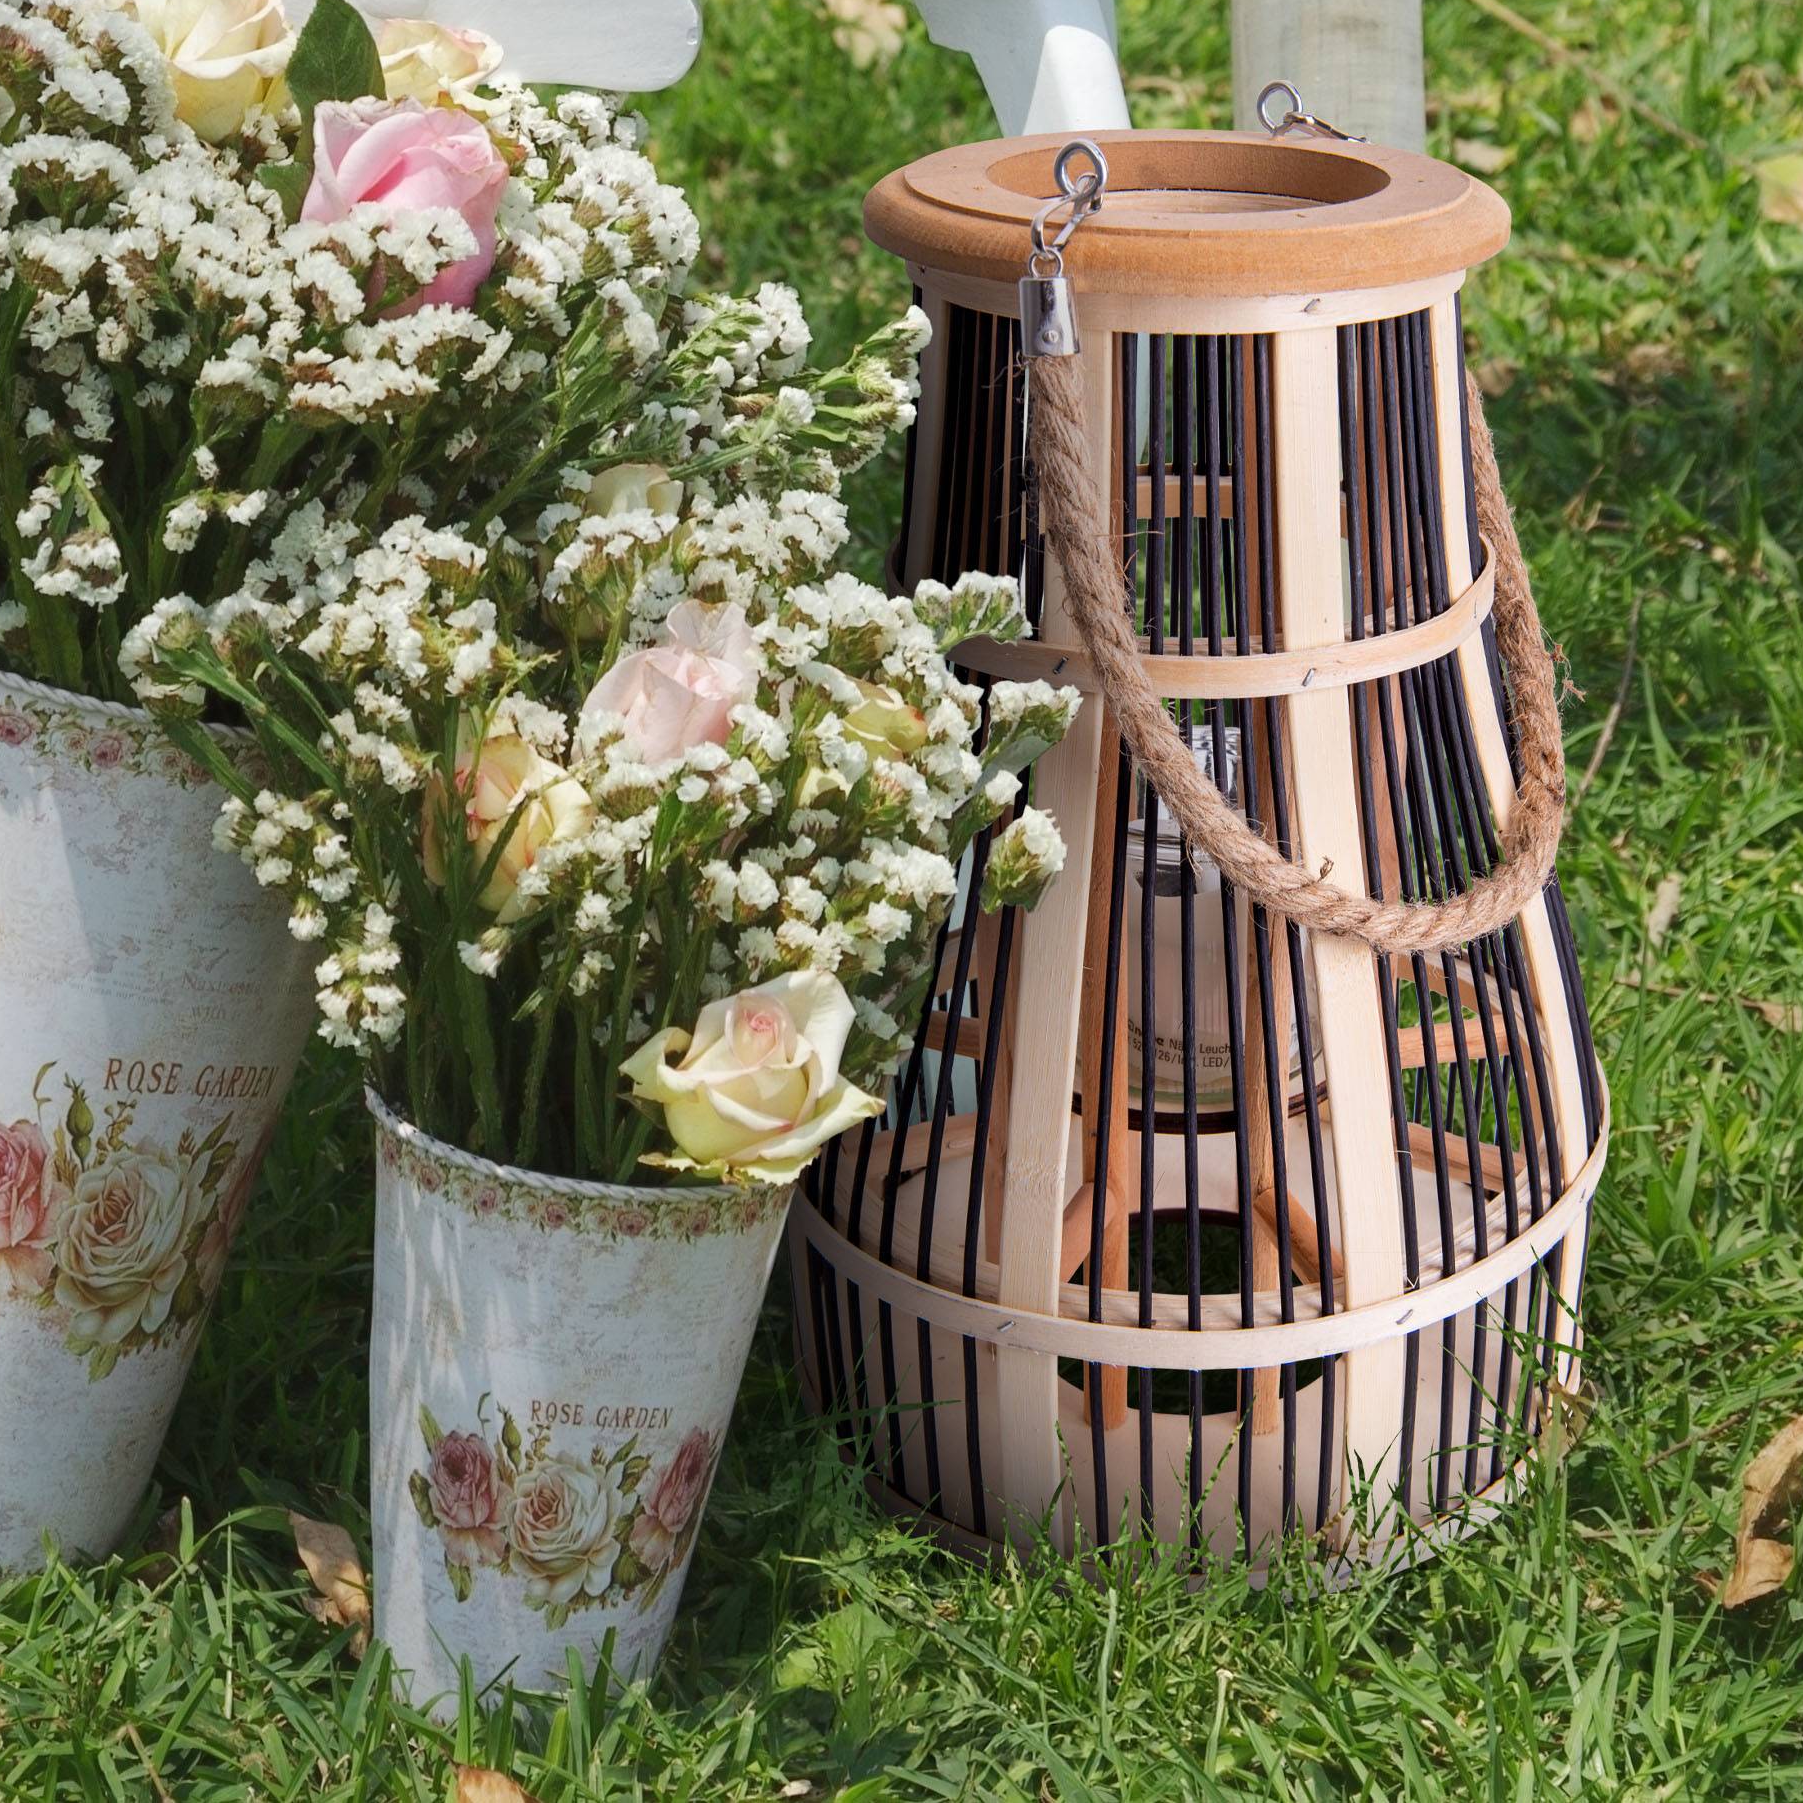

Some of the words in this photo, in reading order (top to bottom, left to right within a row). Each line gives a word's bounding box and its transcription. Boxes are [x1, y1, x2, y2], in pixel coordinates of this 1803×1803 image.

[103, 1058, 183, 1095] ROSE
[196, 1064, 279, 1102] GARDEN
[531, 1400, 584, 1426] ROSE
[596, 1405, 673, 1429] GARDEN
